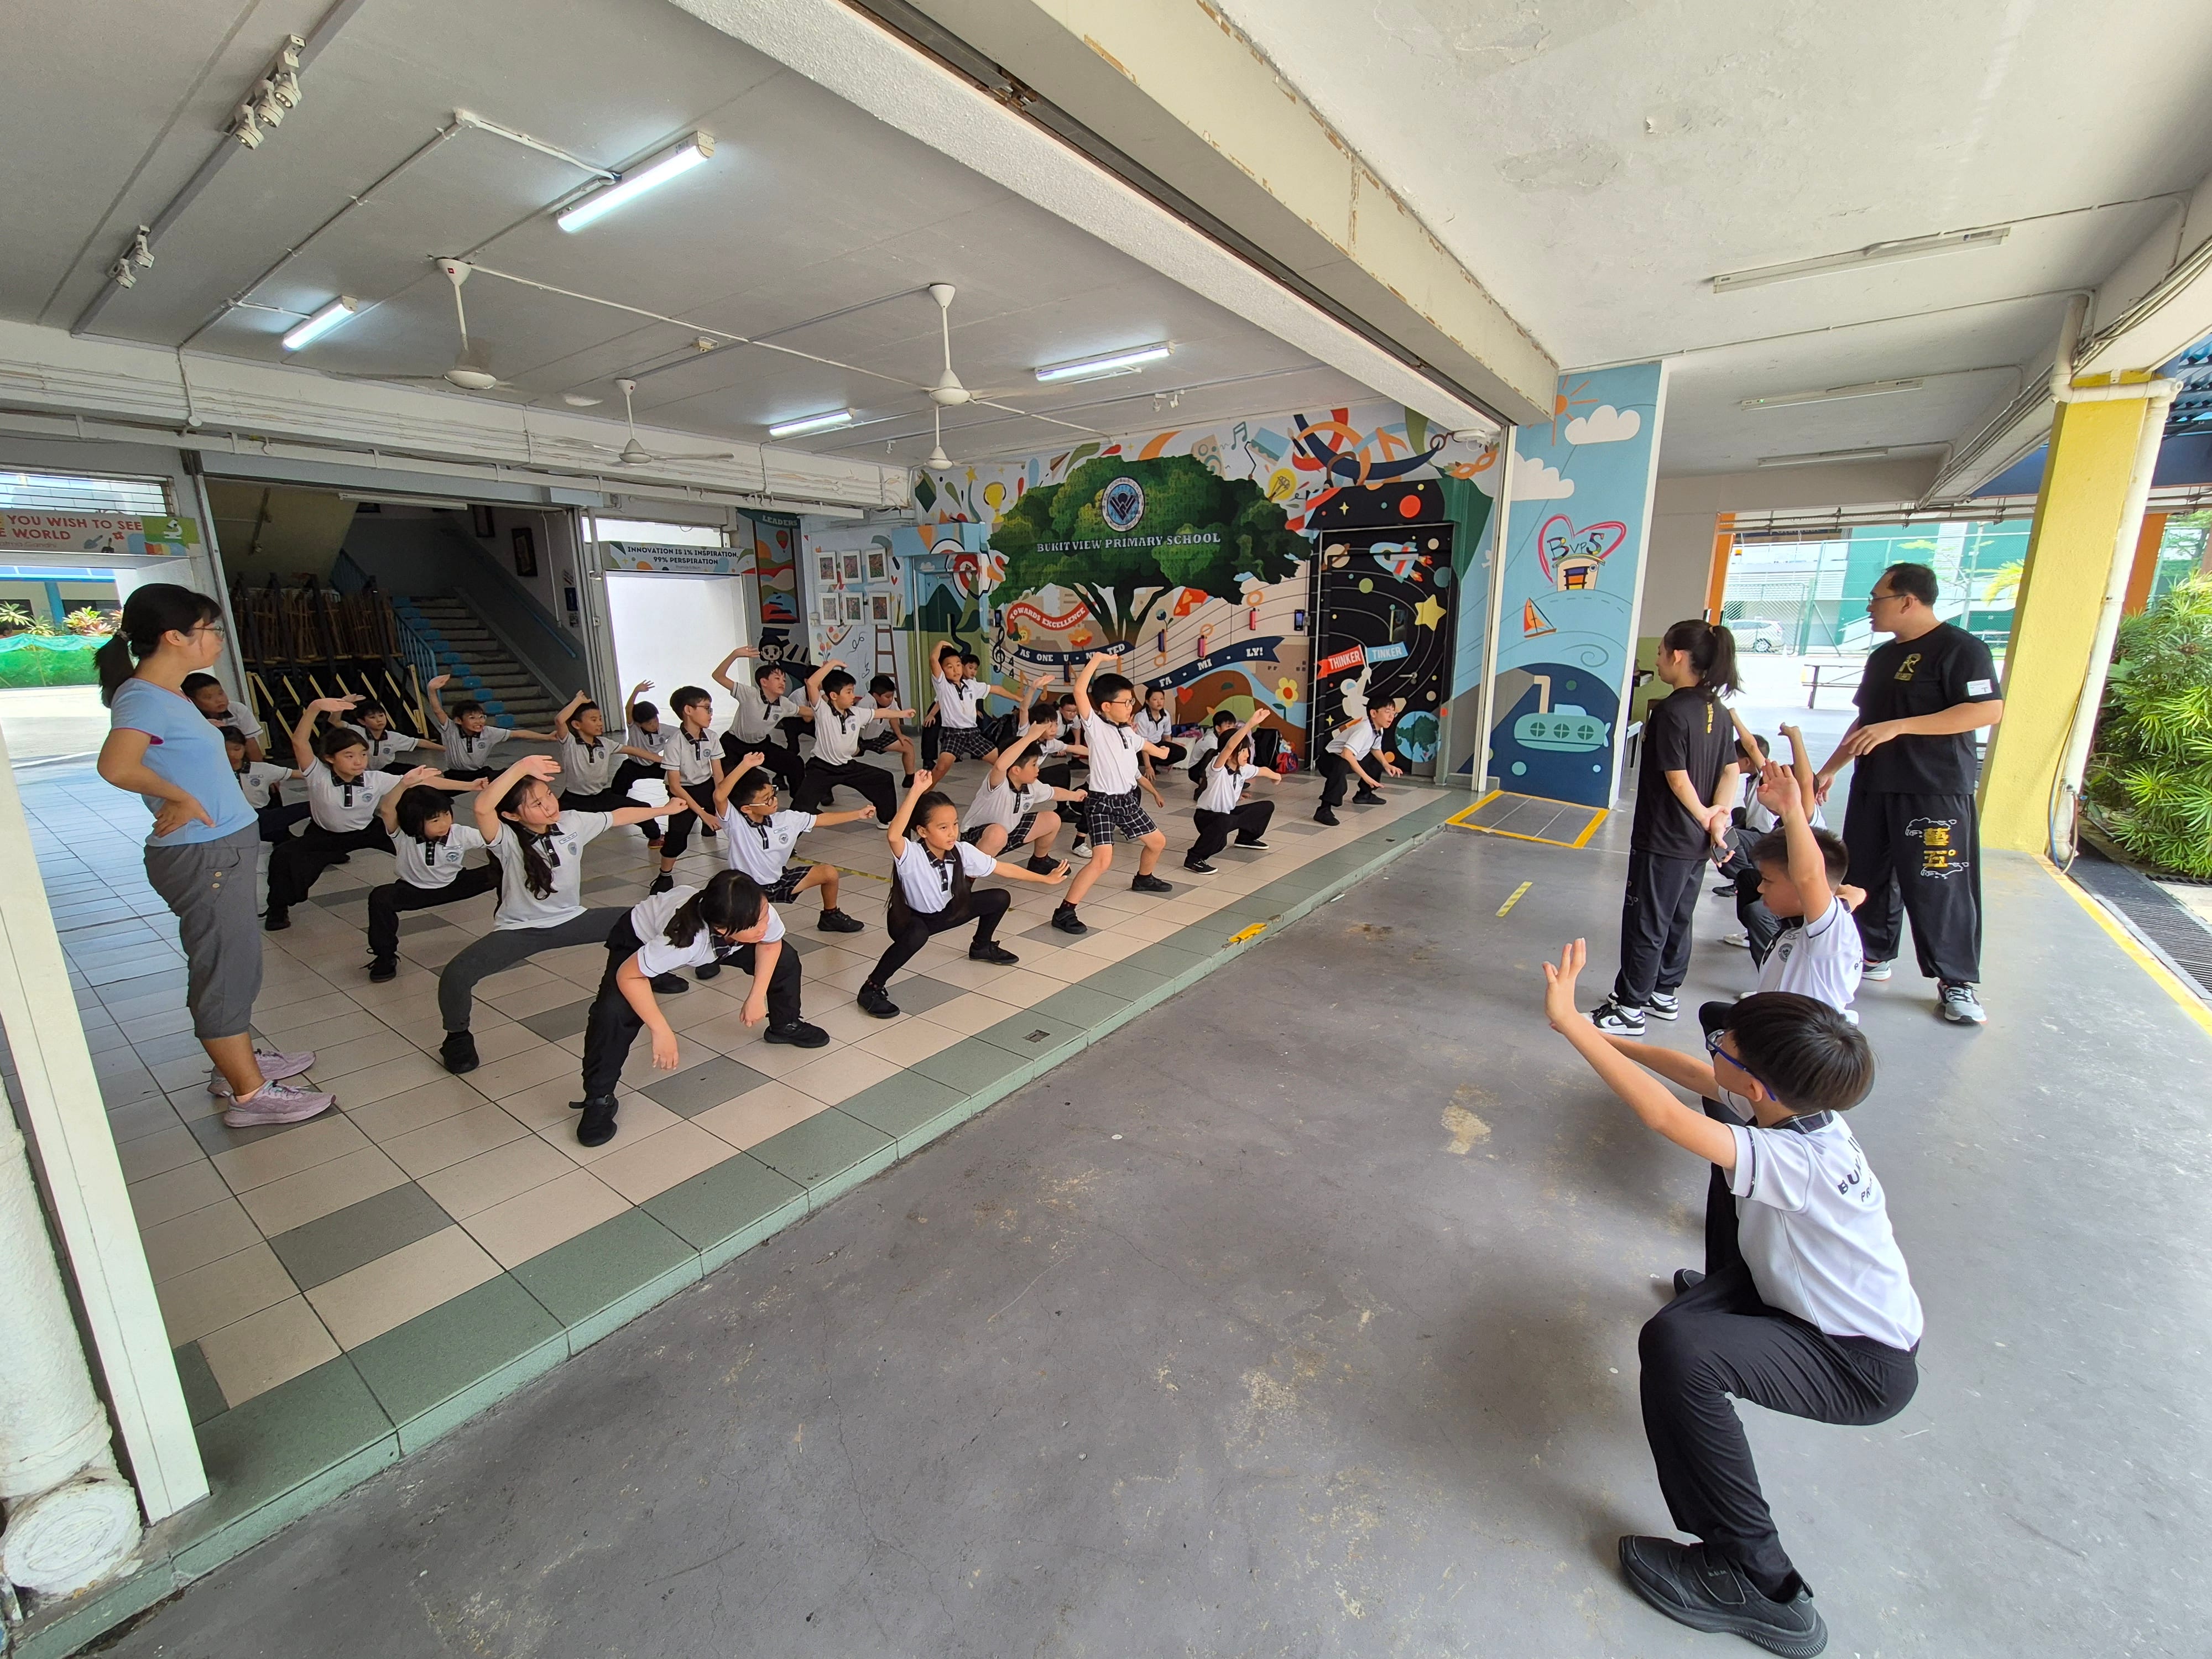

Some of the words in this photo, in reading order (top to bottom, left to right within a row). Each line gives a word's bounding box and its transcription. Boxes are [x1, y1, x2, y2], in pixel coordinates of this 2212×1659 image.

[7, 515, 41, 525] YOU
[46, 517, 87, 528] WISH
[91, 519, 112, 529] TO
[117, 521, 143, 531] SEE
[762, 515, 797, 526] LEADERS
[12, 528, 71, 540] WORLD
[1037, 541, 1071, 552] BUKIT
[1073, 539, 1102, 550] VIEW
[1105, 536, 1164, 549] PRIMARY
[1166, 533, 1221, 545] SCHOOL
[628, 546, 674, 555] INNOVATION
[1010, 607, 1041, 621] TOWARDS
[1042, 606, 1086, 628] EXCELLENCE
[1020, 649, 1030, 658] AS
[1036, 654, 1053, 662] ONE
[1107, 643, 1125, 655] TED
[1328, 651, 1361, 670] THINKER
[1371, 646, 1402, 660] TINKER
[1159, 676, 1173, 687] FA
[1197, 658, 1213, 671] MI
[1246, 647, 1264, 657] LY!
